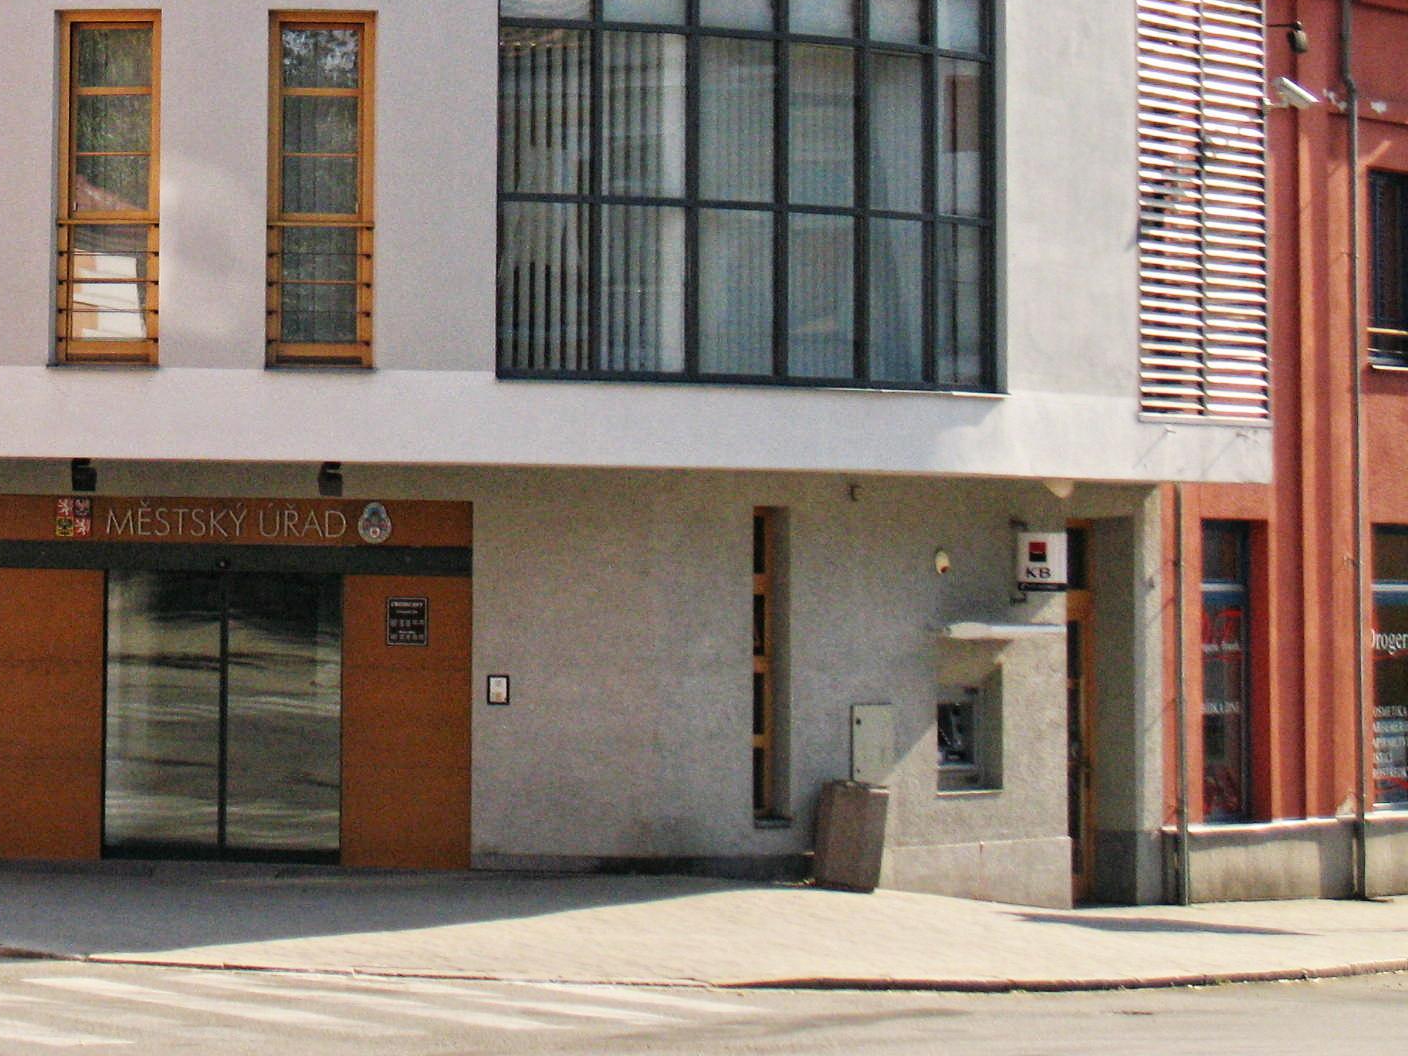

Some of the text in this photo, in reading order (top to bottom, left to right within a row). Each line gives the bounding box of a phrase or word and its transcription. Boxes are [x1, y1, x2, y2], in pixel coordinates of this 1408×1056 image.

[105, 500, 347, 539] MĚSTSKÝ ÚŘAD
[1025, 567, 1052, 579] KB
